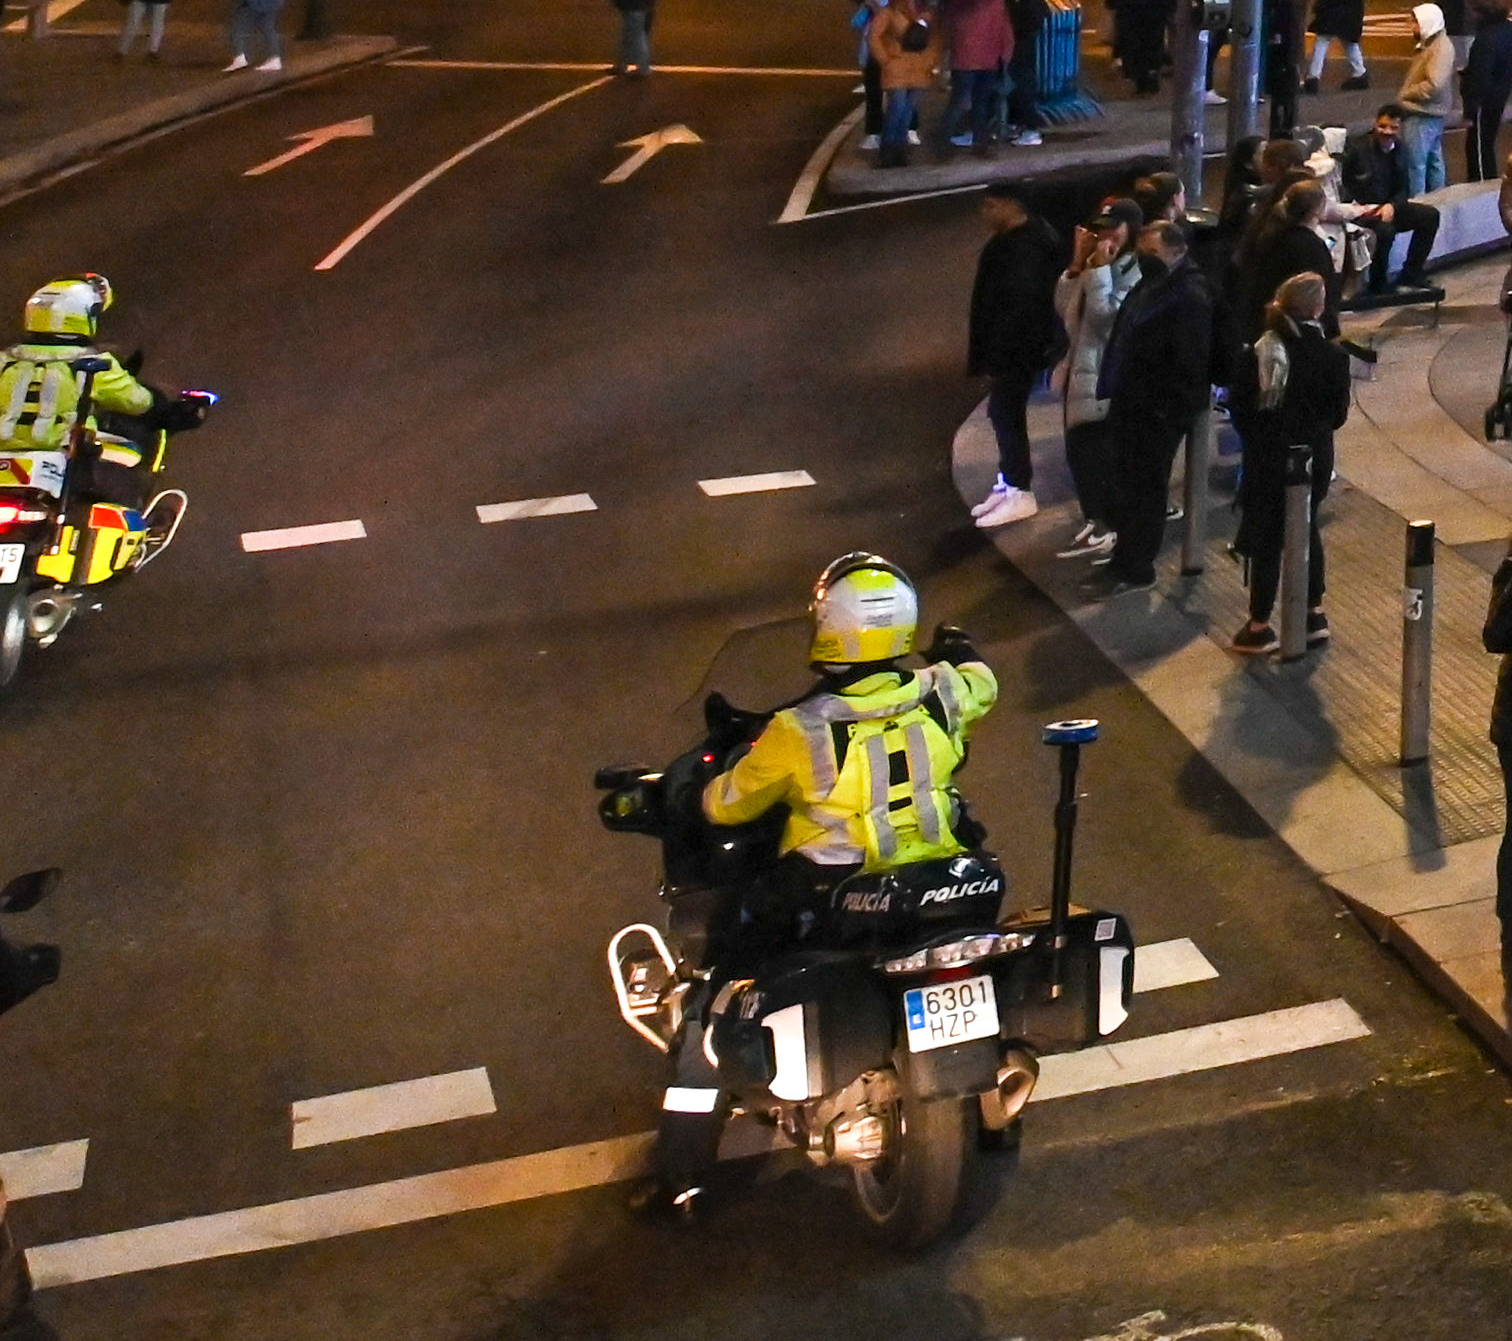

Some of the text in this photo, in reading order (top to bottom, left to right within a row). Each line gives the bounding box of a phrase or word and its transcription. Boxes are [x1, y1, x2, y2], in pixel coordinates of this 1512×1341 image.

[919, 875, 1000, 906] POLICÍA
[926, 980, 987, 1015] 6301
[929, 1009, 978, 1042] HZP
